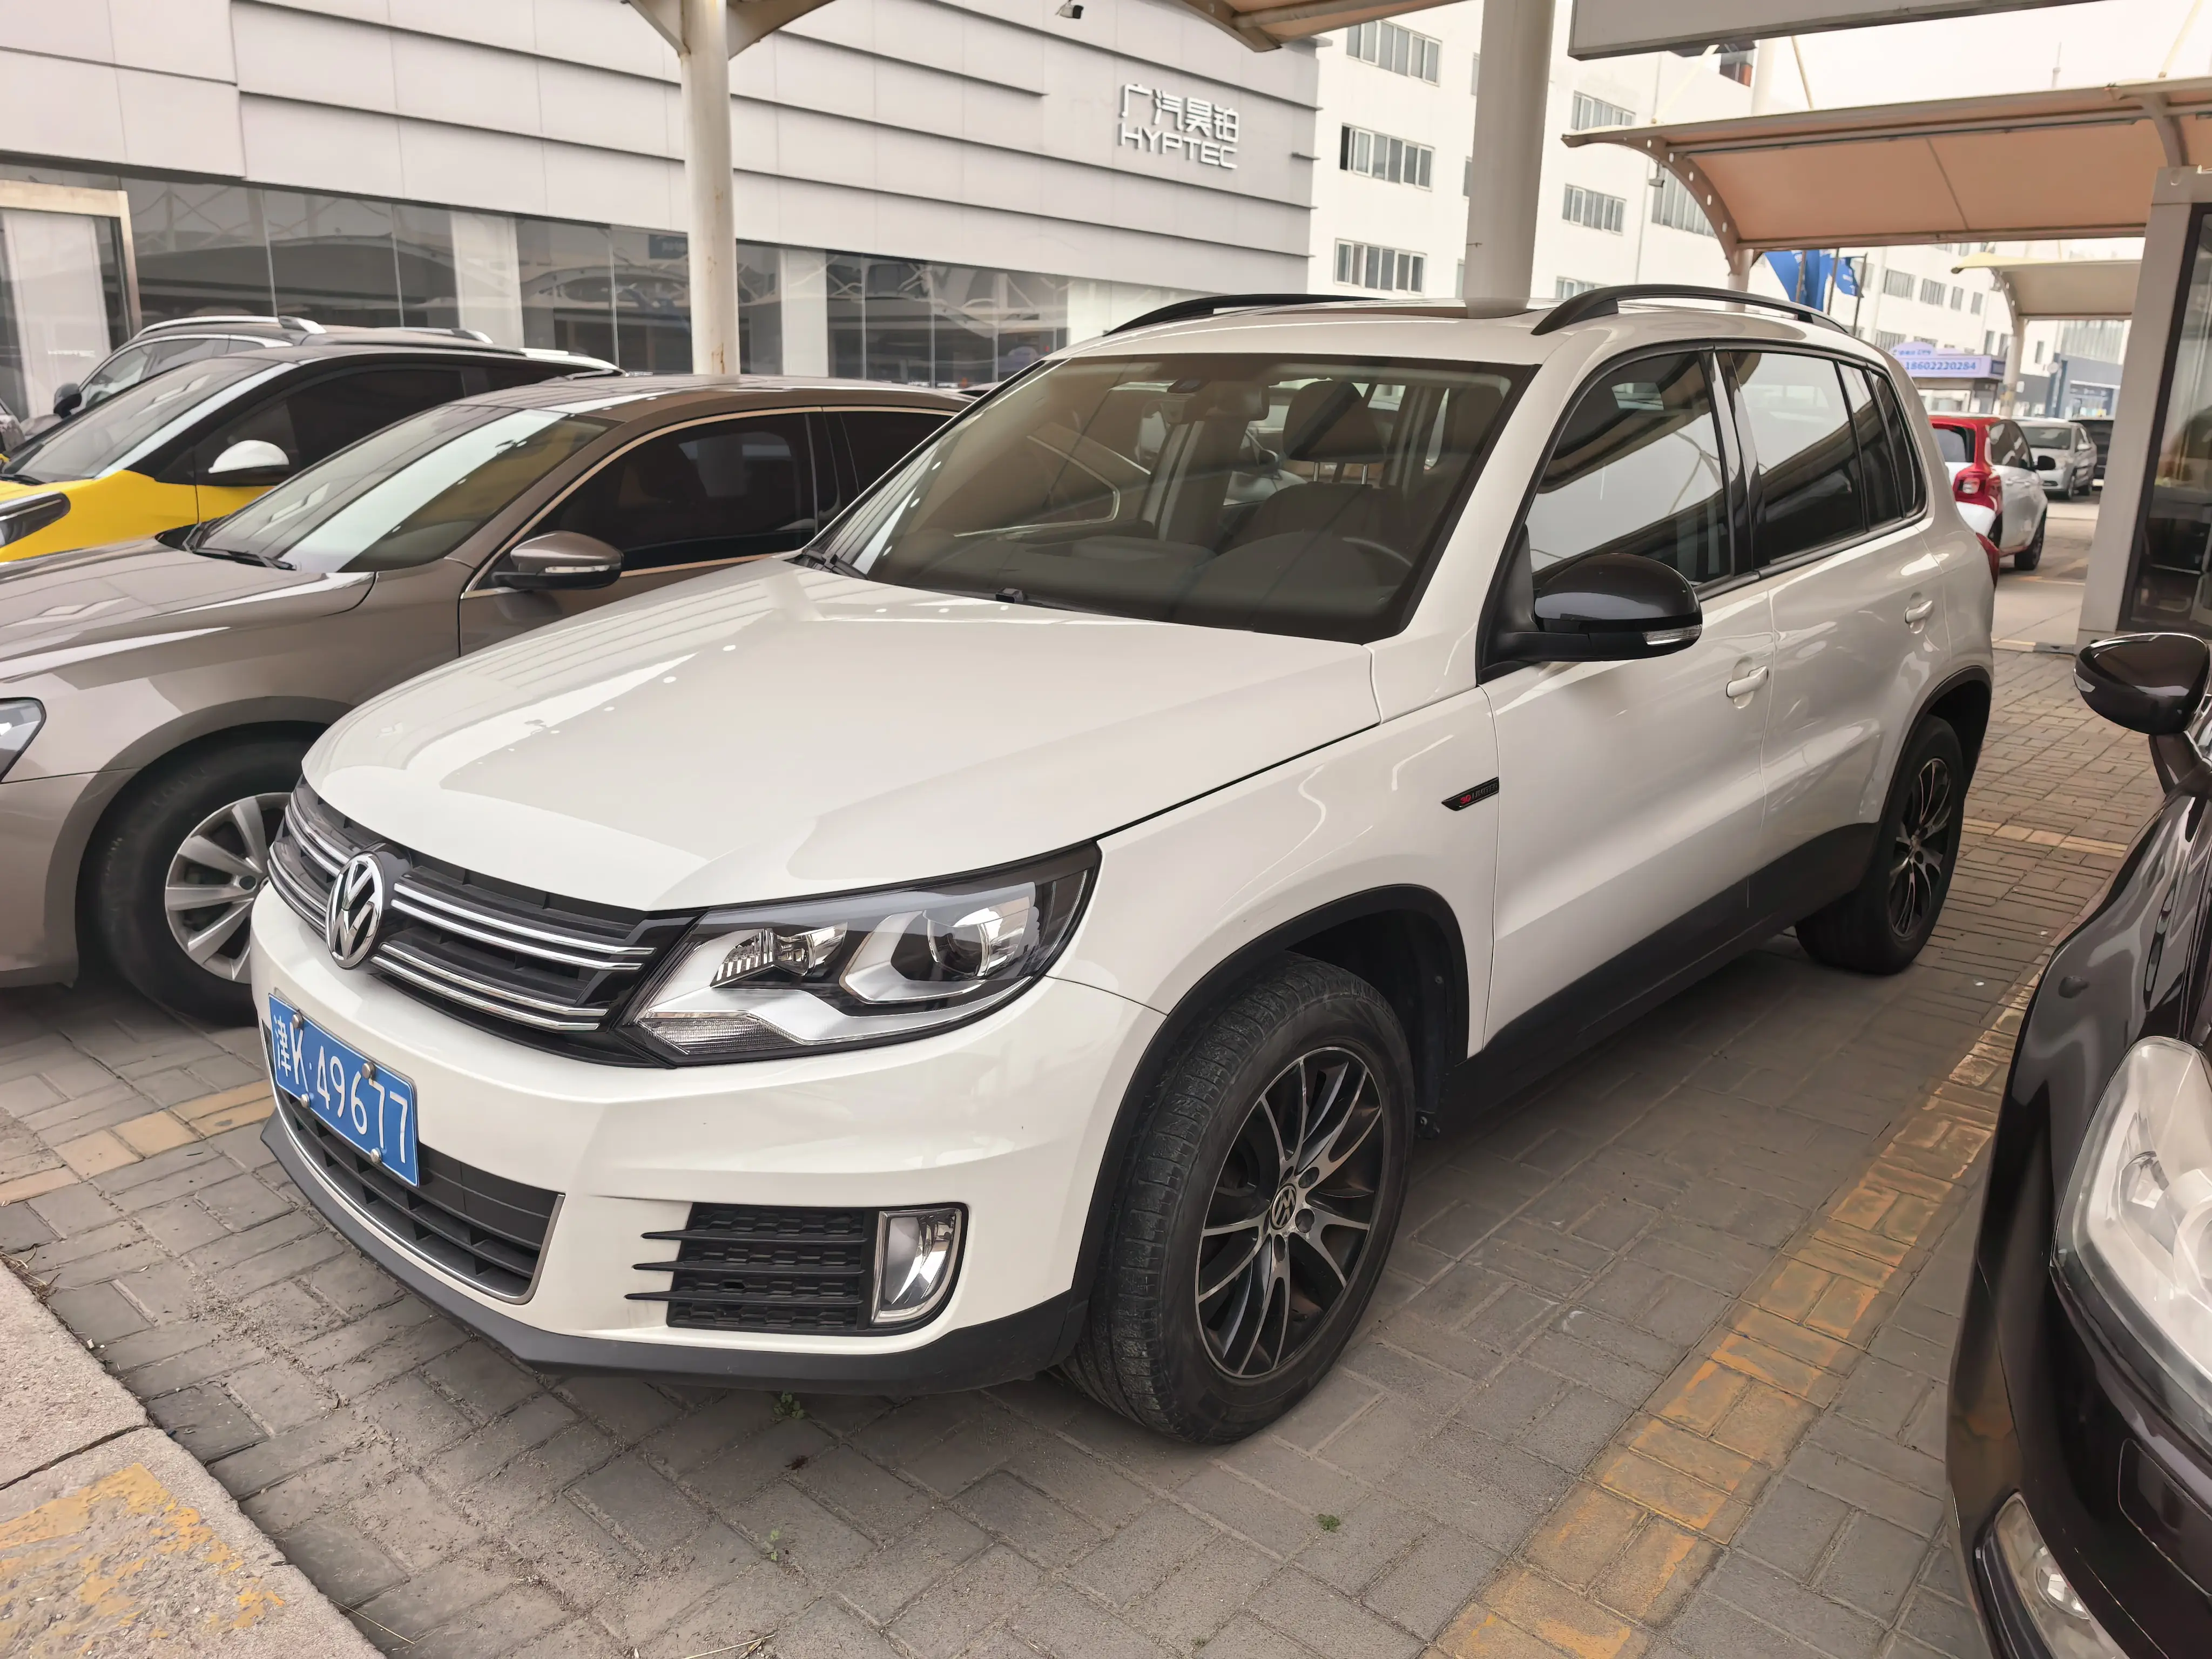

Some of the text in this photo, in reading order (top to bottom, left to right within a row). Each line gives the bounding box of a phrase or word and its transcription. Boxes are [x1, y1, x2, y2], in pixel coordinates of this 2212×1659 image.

[1121, 83, 1240, 143] 广汽昊铂
[1118, 122, 1238, 170] HYPTEC
